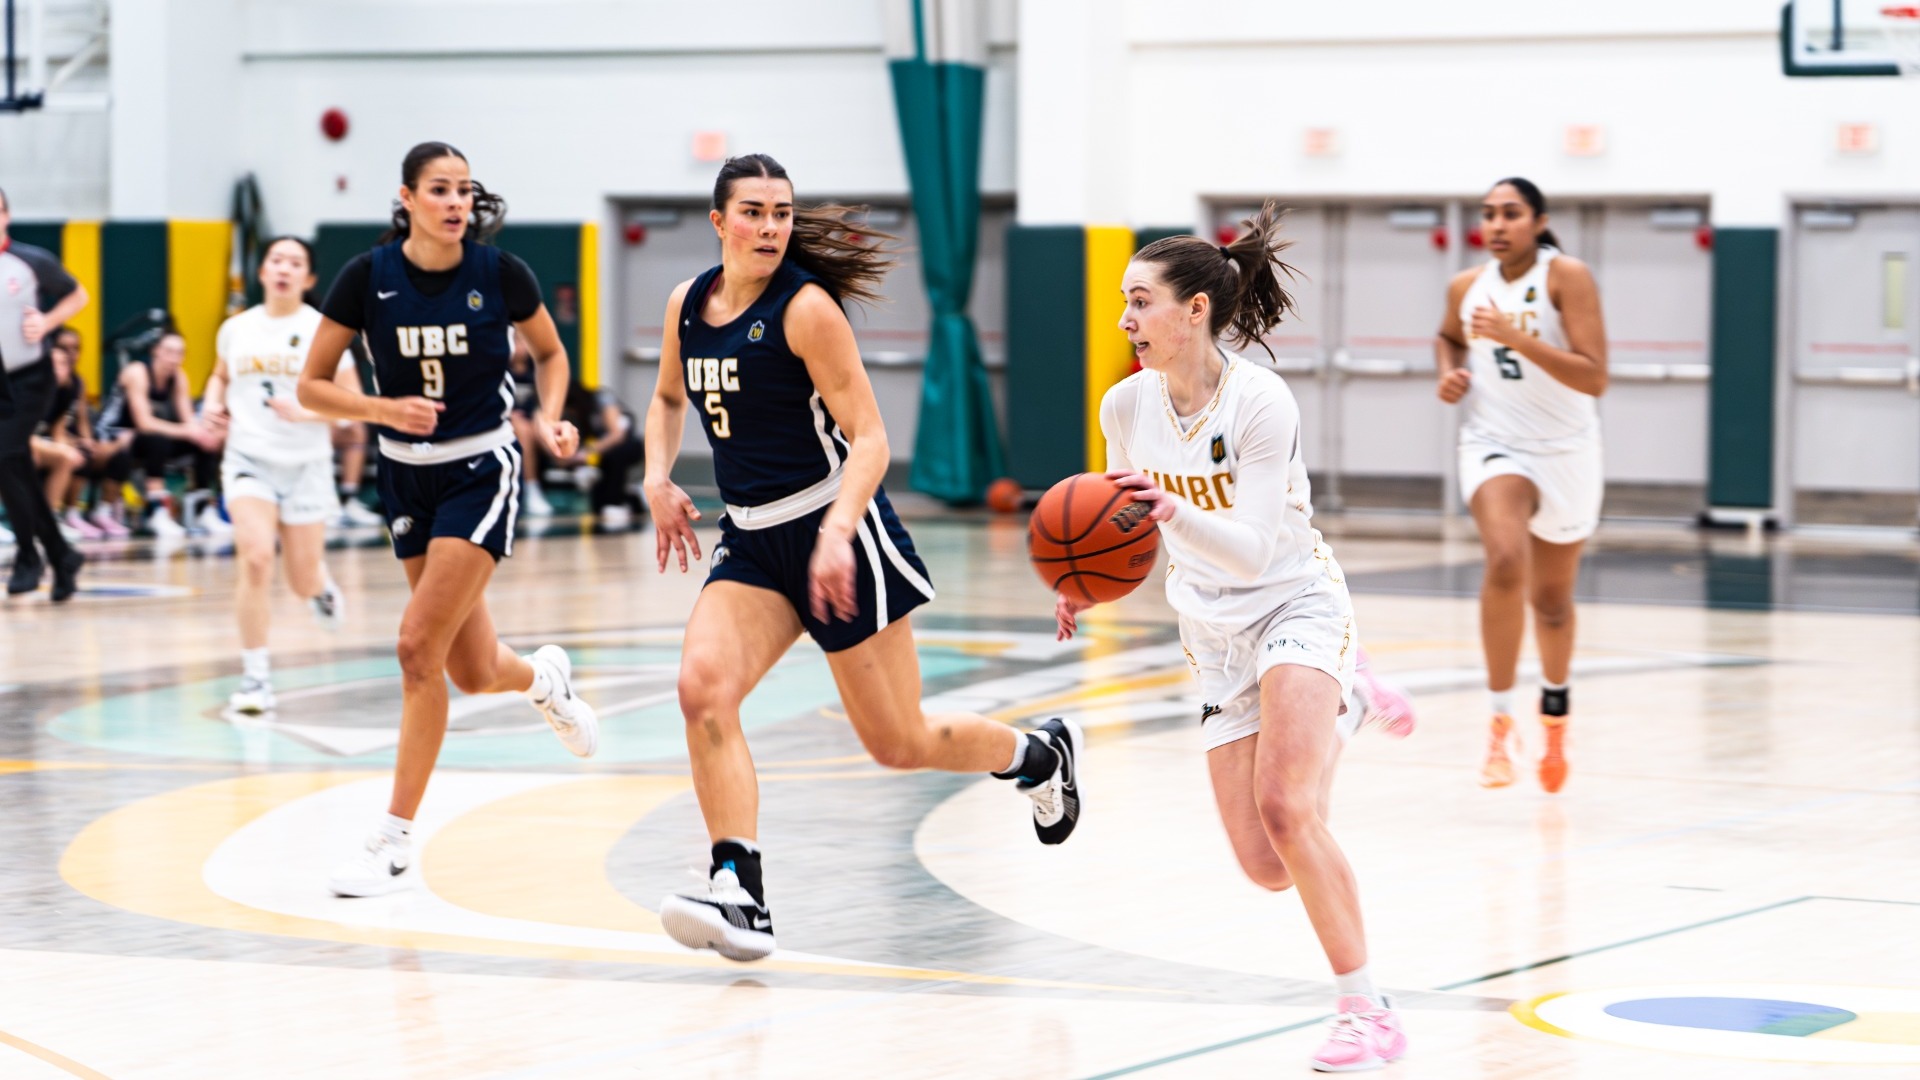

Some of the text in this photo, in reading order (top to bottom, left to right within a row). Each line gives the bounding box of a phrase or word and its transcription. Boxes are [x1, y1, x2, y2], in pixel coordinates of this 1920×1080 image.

[396, 323, 469, 358] UBC
[420, 358, 445, 399] 9
[687, 357, 740, 392] UBC
[704, 392, 731, 438] 5
